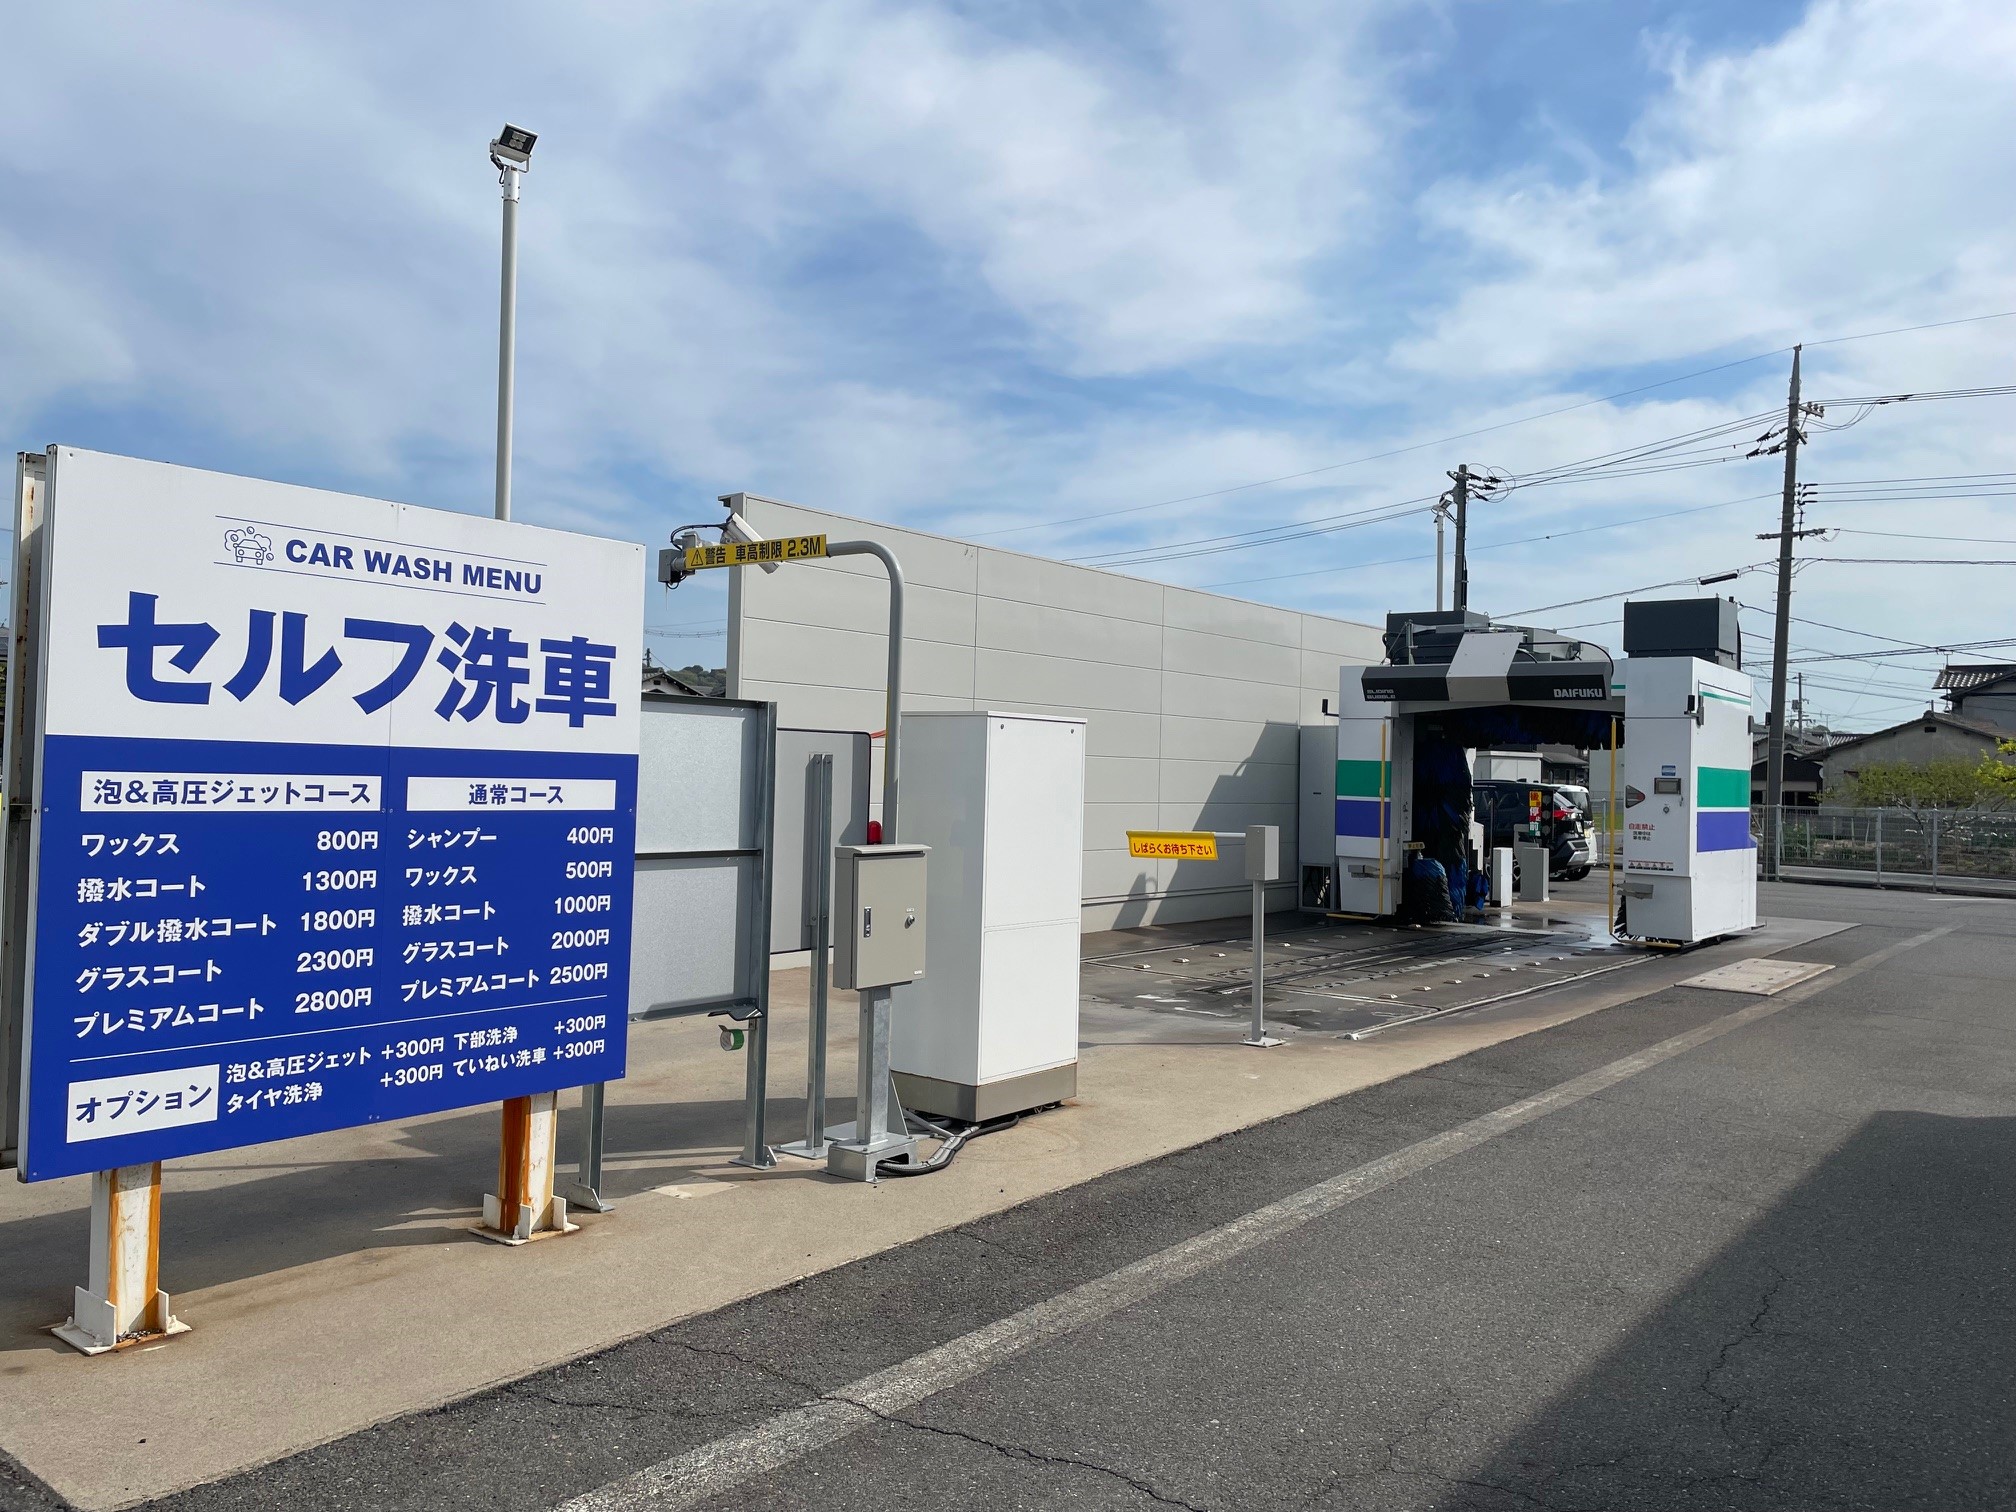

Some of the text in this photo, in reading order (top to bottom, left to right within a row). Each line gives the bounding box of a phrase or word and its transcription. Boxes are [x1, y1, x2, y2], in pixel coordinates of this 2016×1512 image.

[285, 539, 543, 595] CAR WASH MENU
[705, 536, 821, 566] 警告 車高制限 2.3M
[97, 591, 616, 728] セルフ洗車
[1553, 688, 1603, 698] DAIFUKU
[94, 779, 370, 805] 泡&高圧ジェットコース
[469, 784, 563, 805] 通常コース
[82, 831, 378, 856] ワックス 800円
[408, 827, 613, 849] シャンプー 400円
[1133, 842, 1212, 855] しばらくお待ち下さい
[78, 870, 376, 902] 撥水コート 1300円
[406, 861, 612, 886] ワックス 500円
[403, 895, 610, 926] 撥水コート 1000円
[78, 910, 374, 947] ダブル撥水コート 1800円
[403, 929, 609, 964] グラスコート 2000円
[76, 949, 373, 993] グラスコート 2300円
[401, 963, 607, 1002] プレミアムコート 2500円
[74, 988, 371, 1038] プレミアムコート 2800円
[454, 1015, 605, 1050] 下部洗浄 +300円
[226, 1037, 443, 1083] 泡&高圧ジェット +300円
[453, 1039, 604, 1076] ていねい洗車 +300円
[76, 1084, 212, 1124] オプション
[226, 1064, 442, 1113] タイヤ洗浄 +300円
